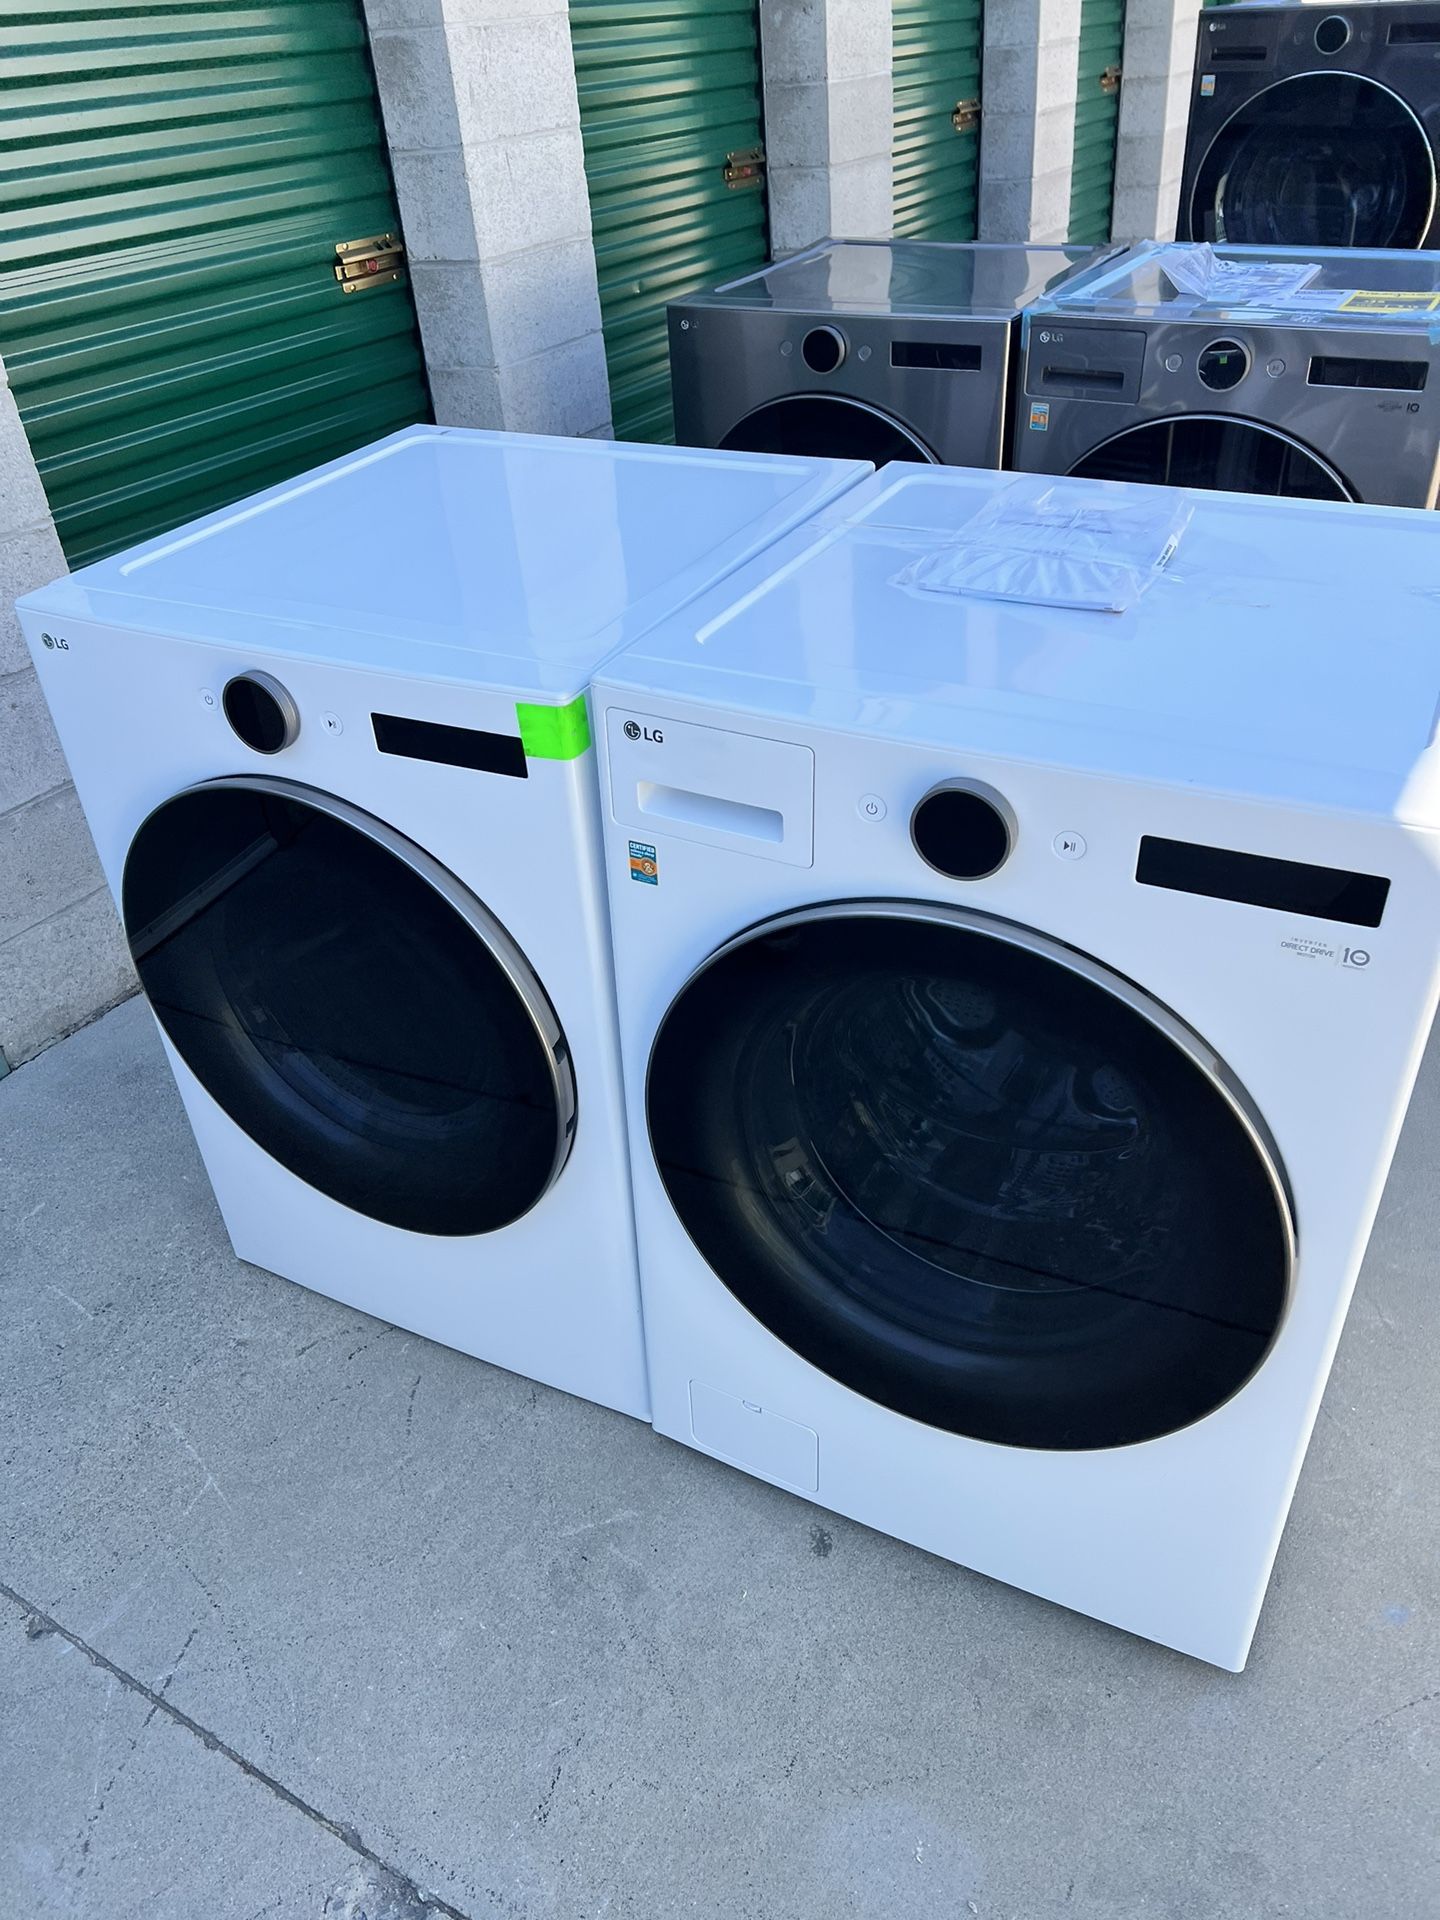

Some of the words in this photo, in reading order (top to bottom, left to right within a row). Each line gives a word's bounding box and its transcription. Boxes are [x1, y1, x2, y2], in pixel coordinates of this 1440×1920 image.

[1280, 941, 1309, 952] DIRECT
[1310, 947, 1335, 958] DRIVE
[1343, 947, 1371, 966] 10
